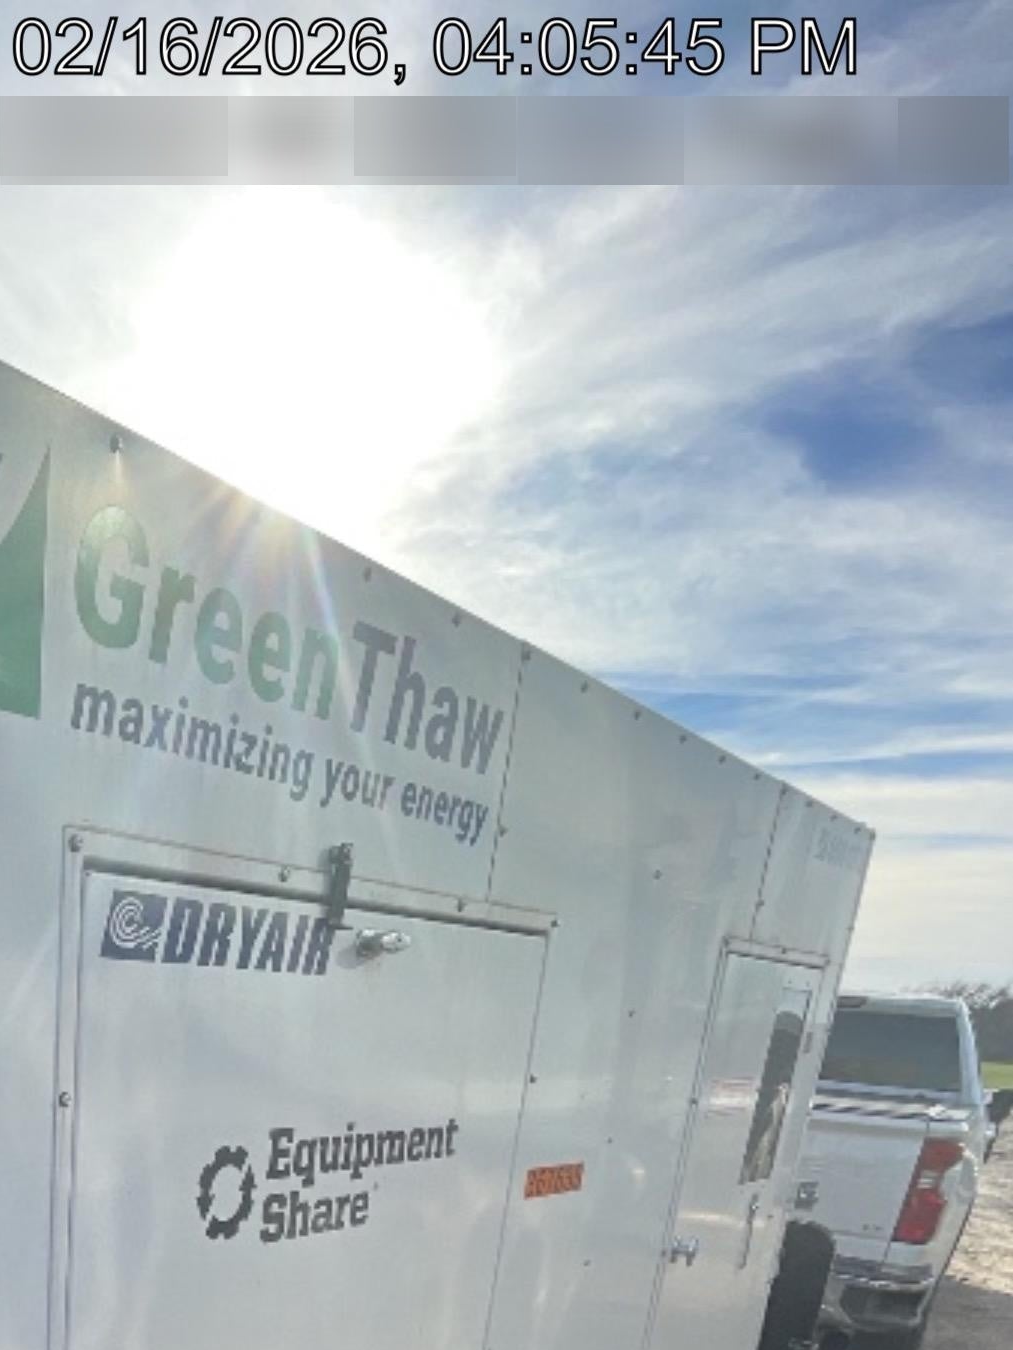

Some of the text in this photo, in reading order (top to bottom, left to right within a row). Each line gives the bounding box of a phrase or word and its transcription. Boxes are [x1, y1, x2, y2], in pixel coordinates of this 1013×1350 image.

[70, 682, 489, 846] maximizing your energy
[160, 896, 336, 976] DRYAIR
[265, 1118, 459, 1187] Equipment
[259, 1187, 370, 1243] Share
